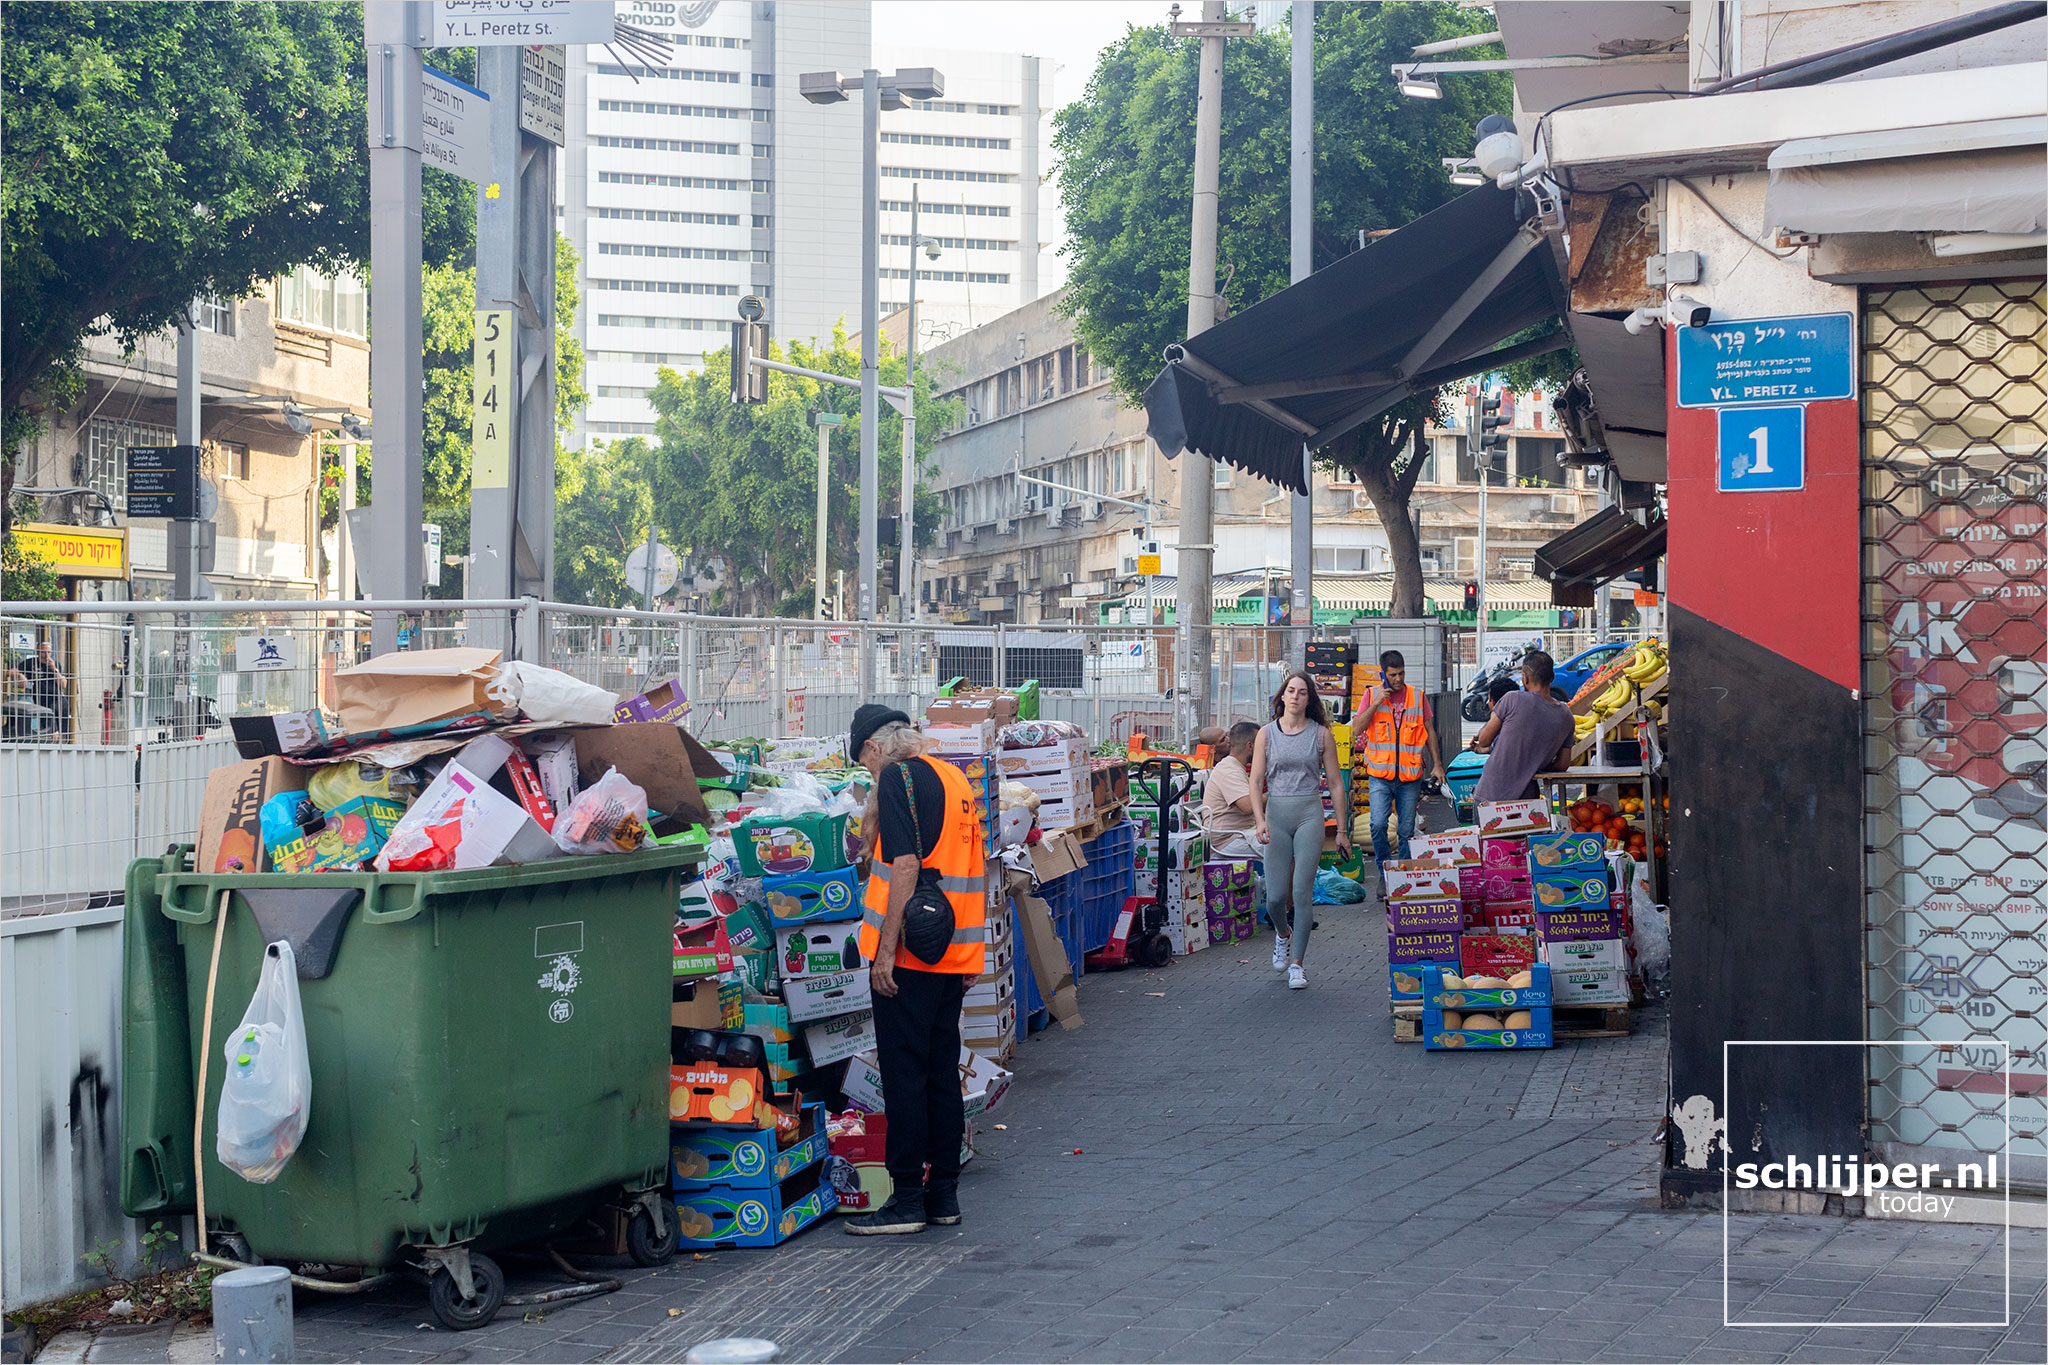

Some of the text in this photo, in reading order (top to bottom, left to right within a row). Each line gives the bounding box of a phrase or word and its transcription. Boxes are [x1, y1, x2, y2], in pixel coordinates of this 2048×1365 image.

[633, 1, 676, 14] מנורה
[446, 22, 553, 36] Y. L. Peretz St.
[1743, 384, 1797, 398] PERETZ
[1748, 427, 1774, 473] 1
[1906, 561, 1950, 576] SONY
[1400, 904, 1457, 915] ביחד ננצח
[1923, 901, 1953, 912] SONY
[2006, 904, 2032, 914] 8MP
[1549, 913, 1609, 924] ביחד ננצח
[1396, 934, 1453, 946] ביחד ננצח
[814, 955, 833, 963] ירקות
[811, 963, 840, 971] מובחרים
[686, 1069, 728, 1084] מלונים
